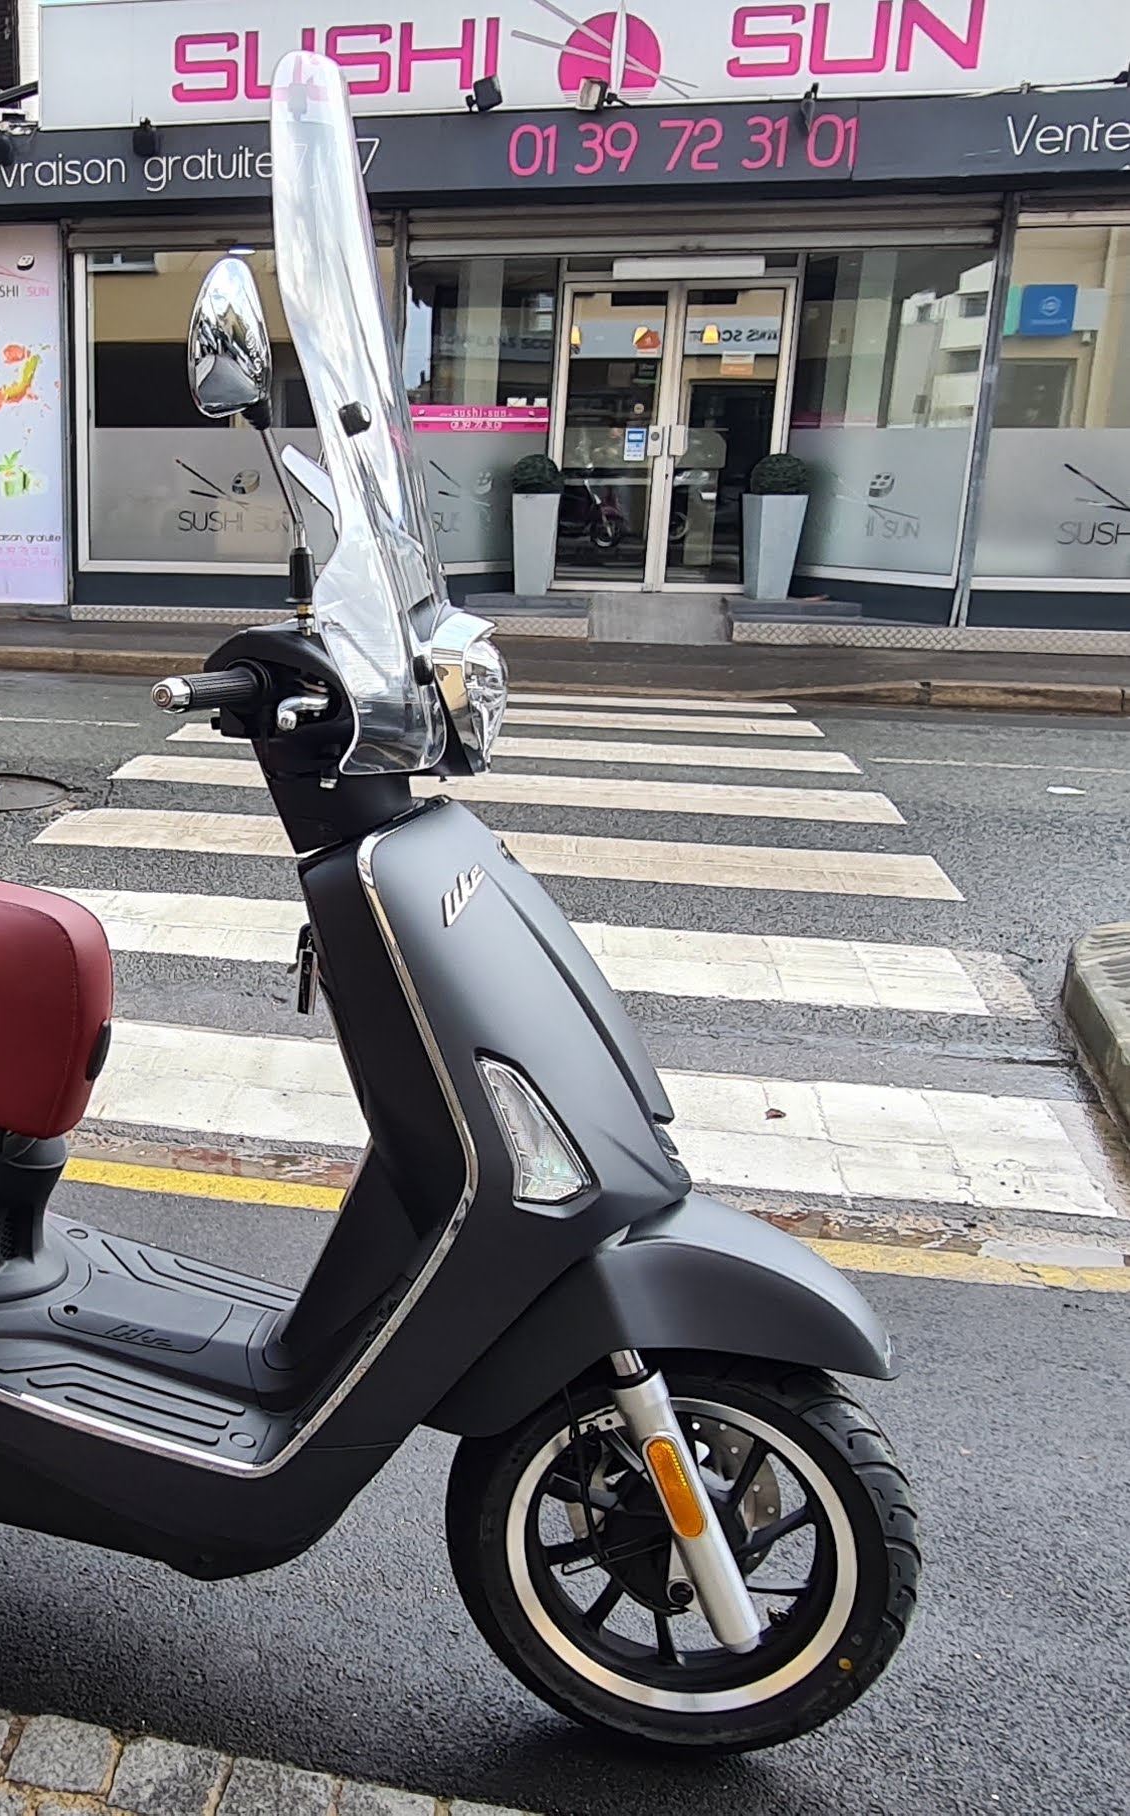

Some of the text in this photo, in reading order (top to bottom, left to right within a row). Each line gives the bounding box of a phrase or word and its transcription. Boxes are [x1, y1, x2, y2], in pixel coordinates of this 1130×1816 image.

[172, 0, 985, 102] SUSHI SUN
[509, 113, 857, 176] 01 39 72 31 01
[1007, 114, 1130, 155] Vente
[144, 145, 274, 192] gratuite
[26, 287, 50, 297] SUN
[178, 510, 243, 532] SUSHI
